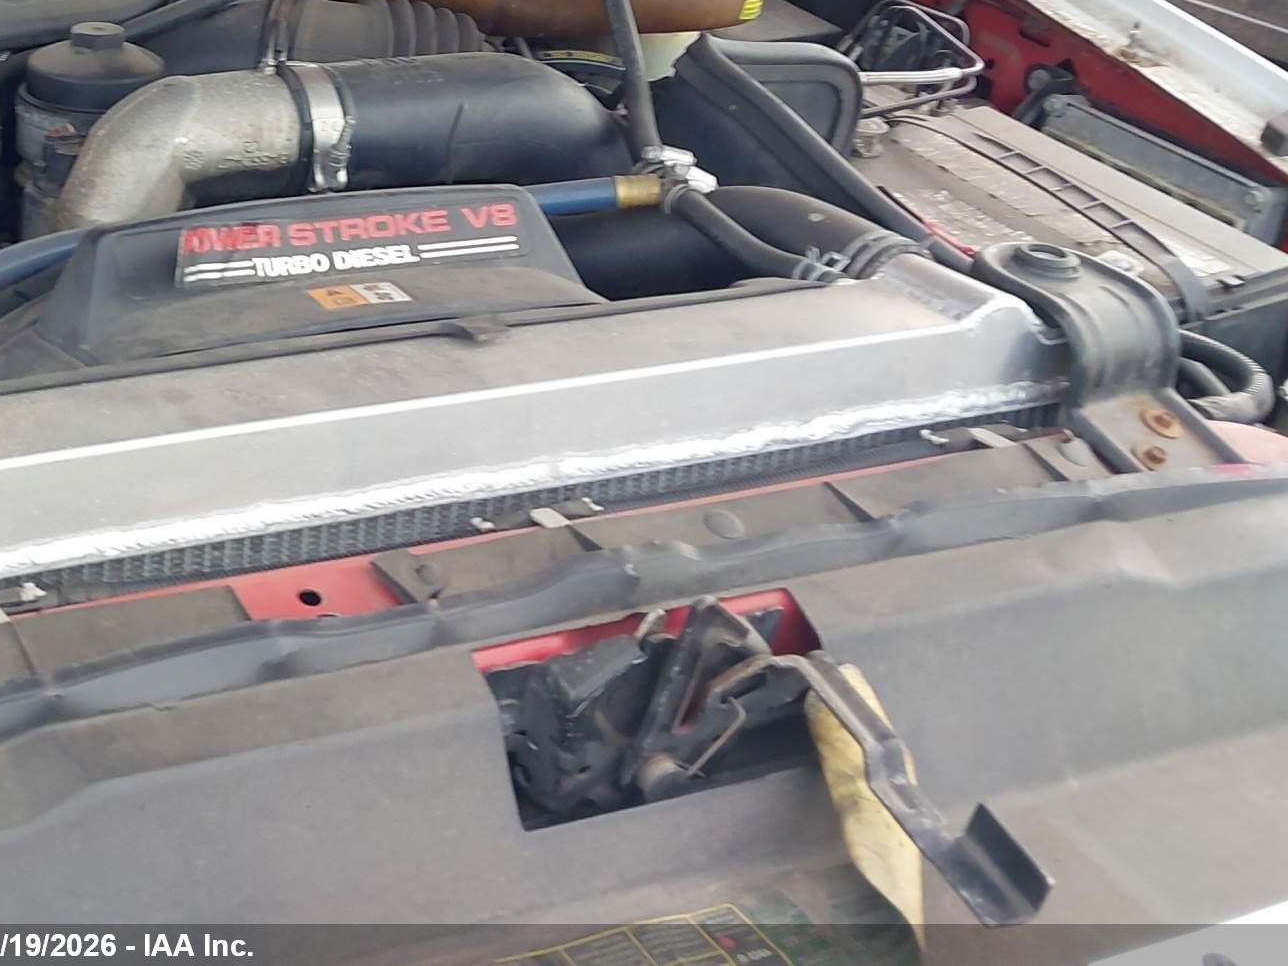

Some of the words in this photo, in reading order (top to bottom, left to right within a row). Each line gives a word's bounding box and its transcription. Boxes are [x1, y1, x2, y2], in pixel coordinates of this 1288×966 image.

[287, 209, 452, 247] STROKE
[460, 203, 519, 230] V8
[252, 252, 331, 278] TURBO
[331, 244, 421, 271] DIESEL
